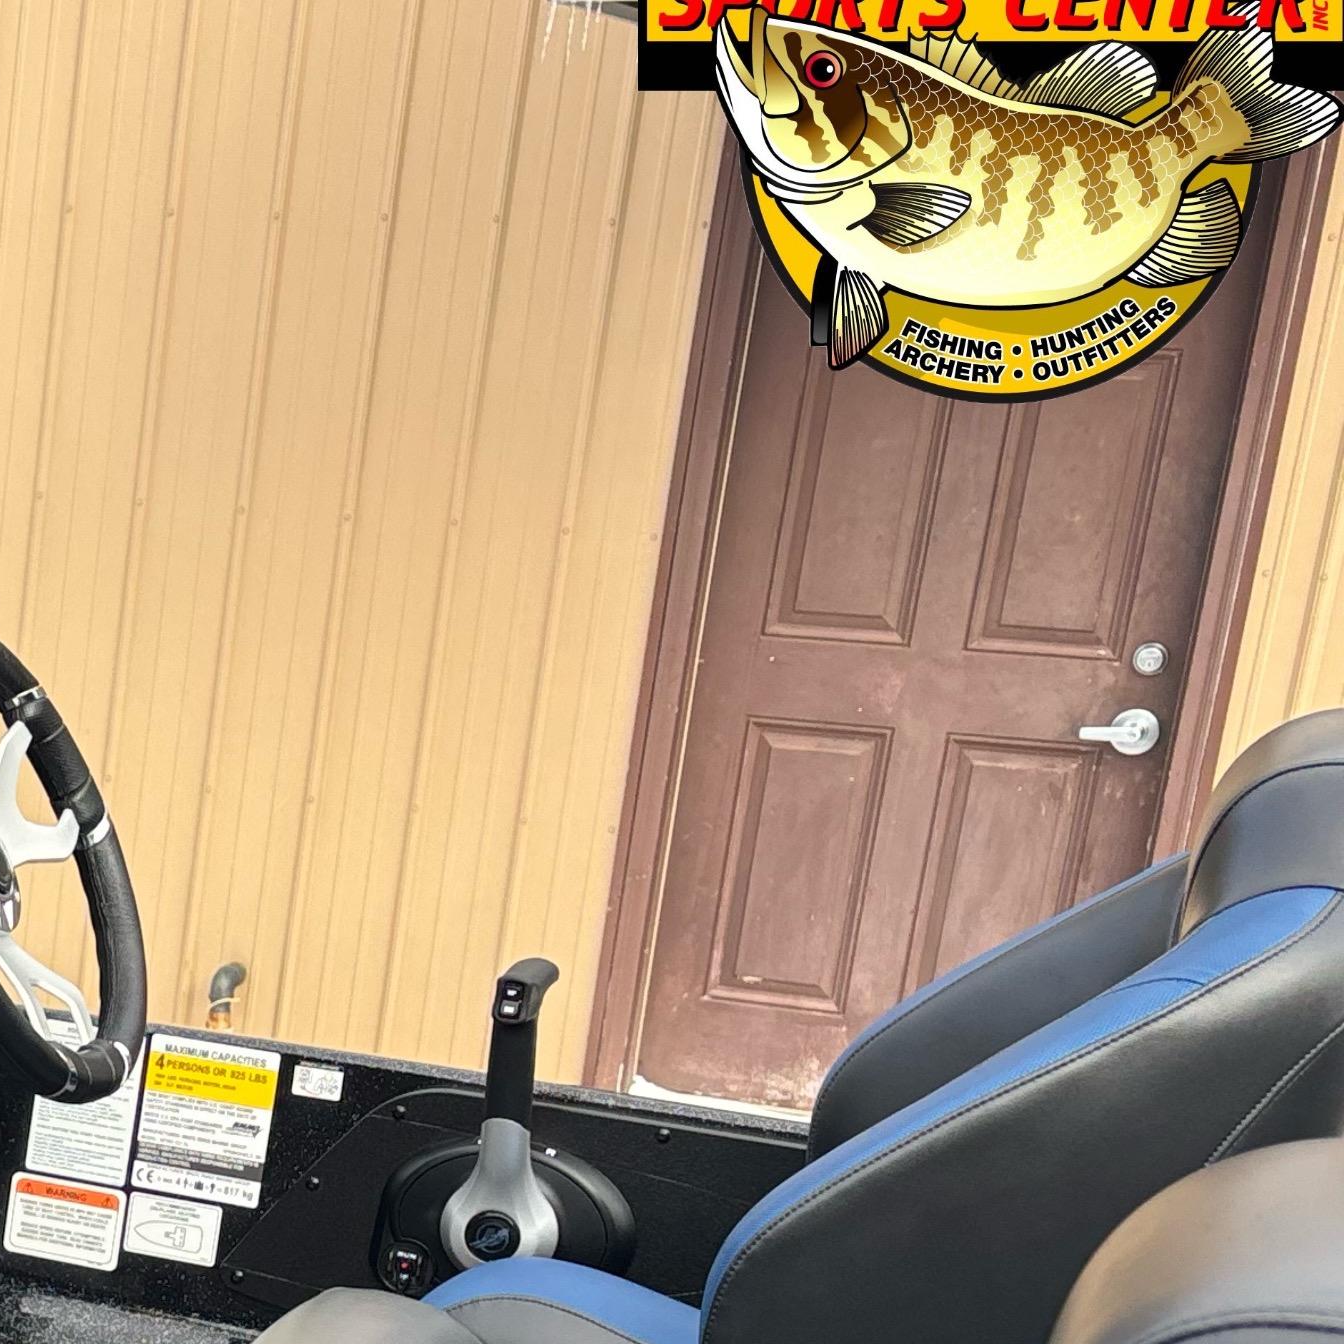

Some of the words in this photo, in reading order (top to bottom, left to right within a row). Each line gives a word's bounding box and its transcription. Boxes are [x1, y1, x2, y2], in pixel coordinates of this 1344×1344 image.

[165, 1044, 209, 1059] MAXIMUM
[211, 1051, 267, 1068] CAPACITIES
[155, 1054, 165, 1070] 4
[166, 1059, 211, 1075] PERSONS
[212, 1068, 226, 1077] OR
[248, 1072, 268, 1084] LBS
[45, 1186, 87, 1202] WARNING
